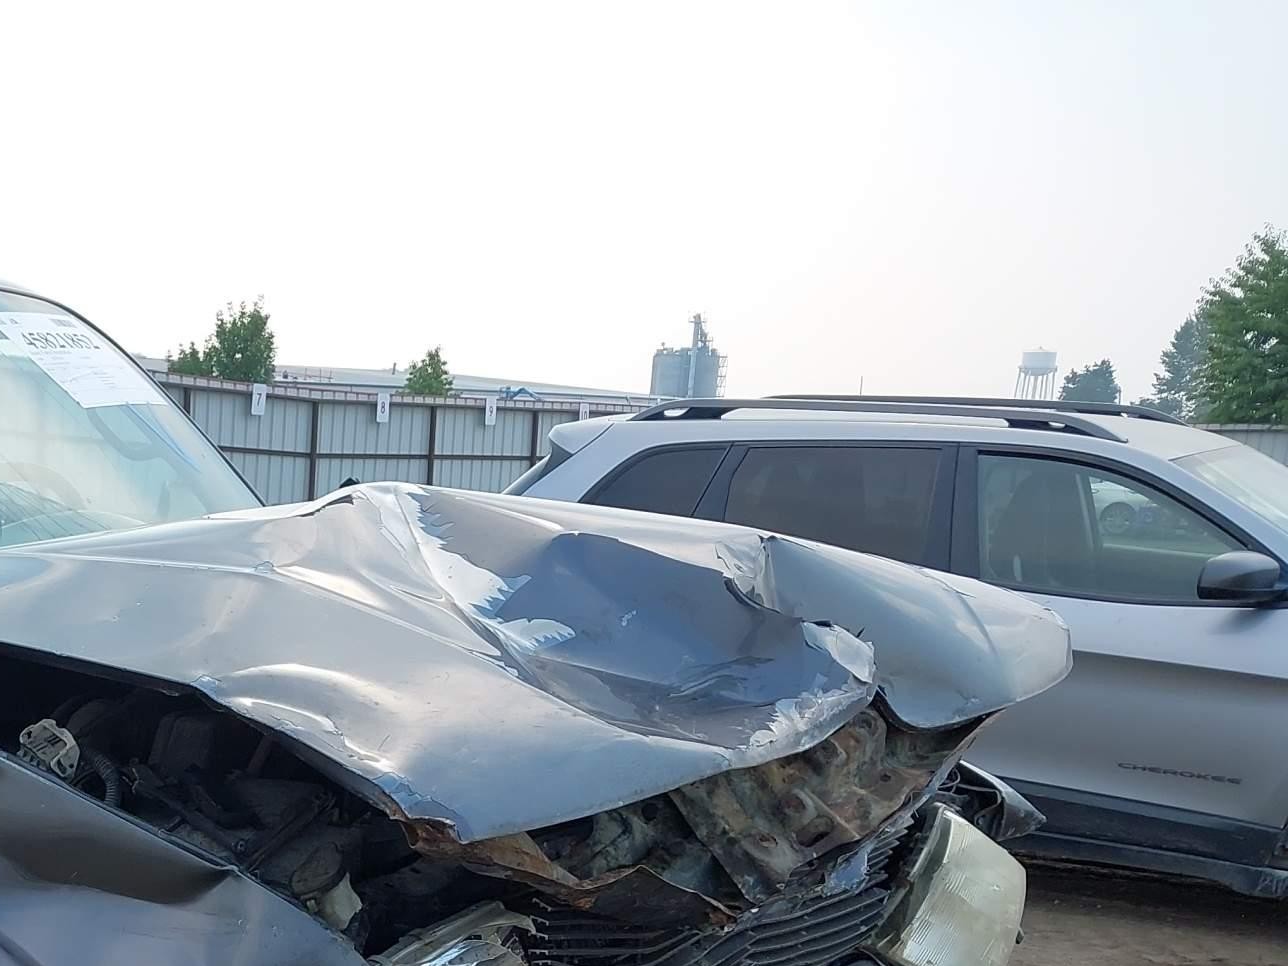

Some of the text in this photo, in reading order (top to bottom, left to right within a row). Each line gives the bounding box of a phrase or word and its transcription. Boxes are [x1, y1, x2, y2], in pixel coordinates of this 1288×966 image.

[21, 332, 101, 349] 45821852
[256, 392, 263, 406] 7
[380, 401, 386, 414] 8
[488, 405, 494, 417] 9
[1117, 762, 1243, 785] CHEROKEE
